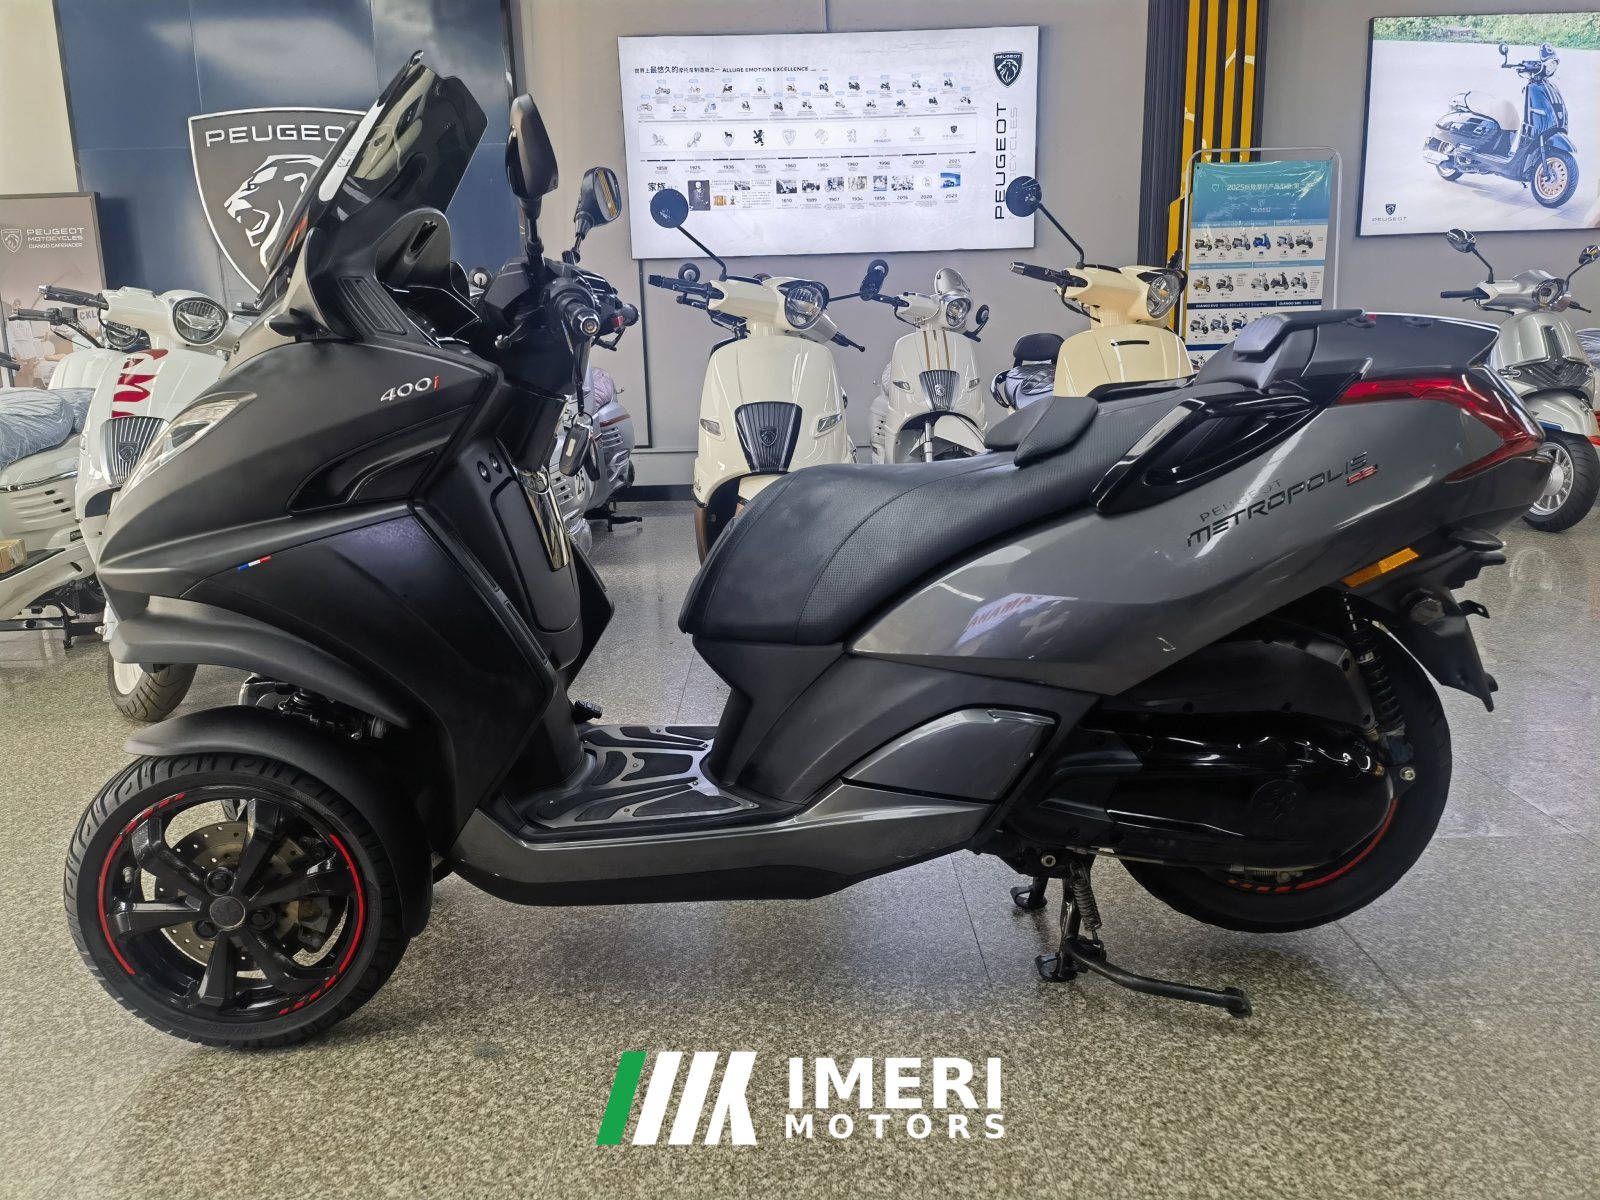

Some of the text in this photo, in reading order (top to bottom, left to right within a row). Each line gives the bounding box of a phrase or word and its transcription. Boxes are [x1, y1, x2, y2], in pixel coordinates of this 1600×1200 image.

[205, 124, 345, 147] PEUGEO
[994, 102, 1007, 220] PEUGEOT
[26, 227, 85, 236] PEUGEOT
[380, 376, 439, 402] 400i
[1187, 451, 1368, 547] METROPOLIS
[1199, 478, 1282, 522] PEUGEOT
